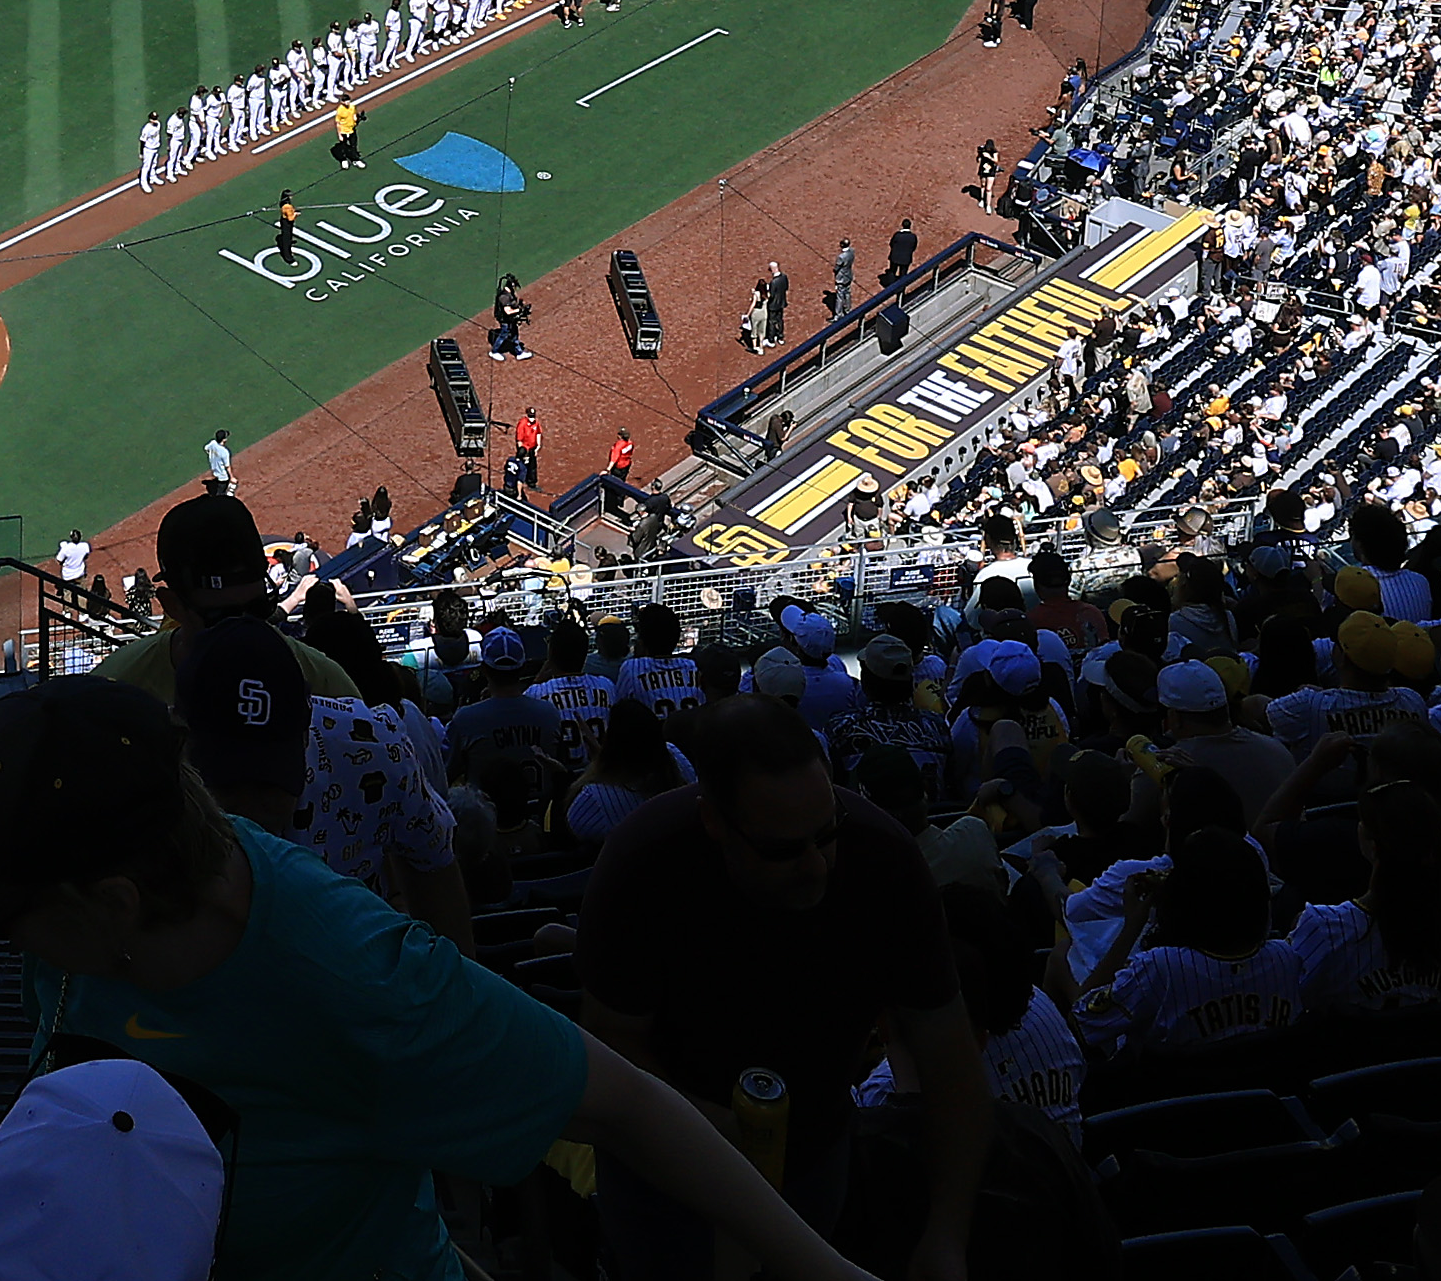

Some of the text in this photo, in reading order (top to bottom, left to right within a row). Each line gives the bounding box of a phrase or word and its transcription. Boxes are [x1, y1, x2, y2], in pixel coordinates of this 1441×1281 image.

[218, 183, 445, 289] blue
[304, 205, 480, 303] CALIFORNIA
[828, 403, 952, 474] FOR
[897, 367, 996, 424] THE
[236, 677, 272, 726] SD
[493, 723, 545, 752] GWYNN
[1187, 994, 1262, 1039] TATIS
